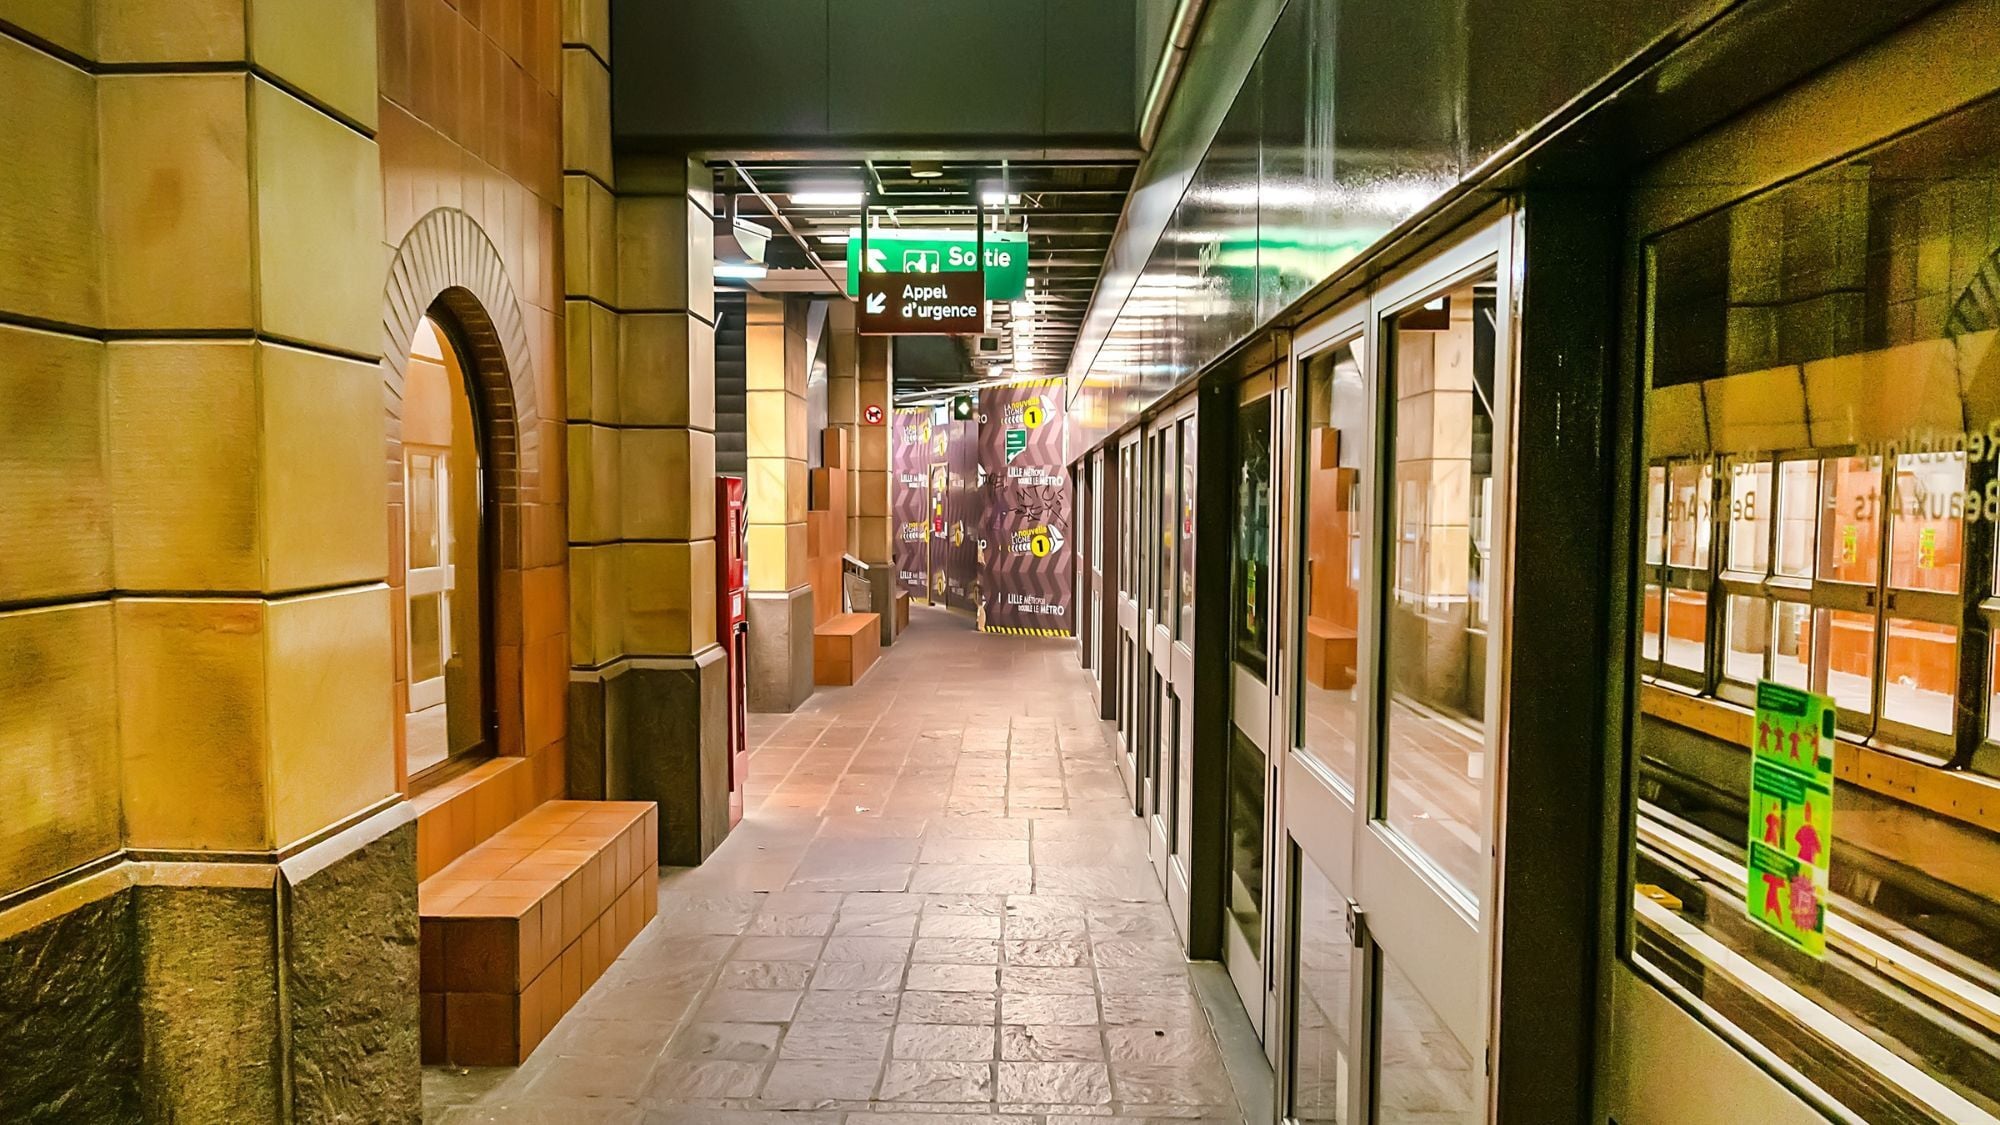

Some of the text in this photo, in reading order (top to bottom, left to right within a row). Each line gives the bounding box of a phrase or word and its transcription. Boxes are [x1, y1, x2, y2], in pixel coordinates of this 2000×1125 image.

[948, 246, 1011, 268] Sotie
[902, 284, 948, 301] Appel
[902, 303, 977, 320] d'urgence
[1029, 411, 1036, 424] 1
[1008, 466, 1024, 478] LILLE
[1037, 540, 1044, 552] 1
[1007, 593, 1023, 604] LILLE
[1033, 605, 1040, 613] LE
[1040, 603, 1065, 616] MÉTRO
